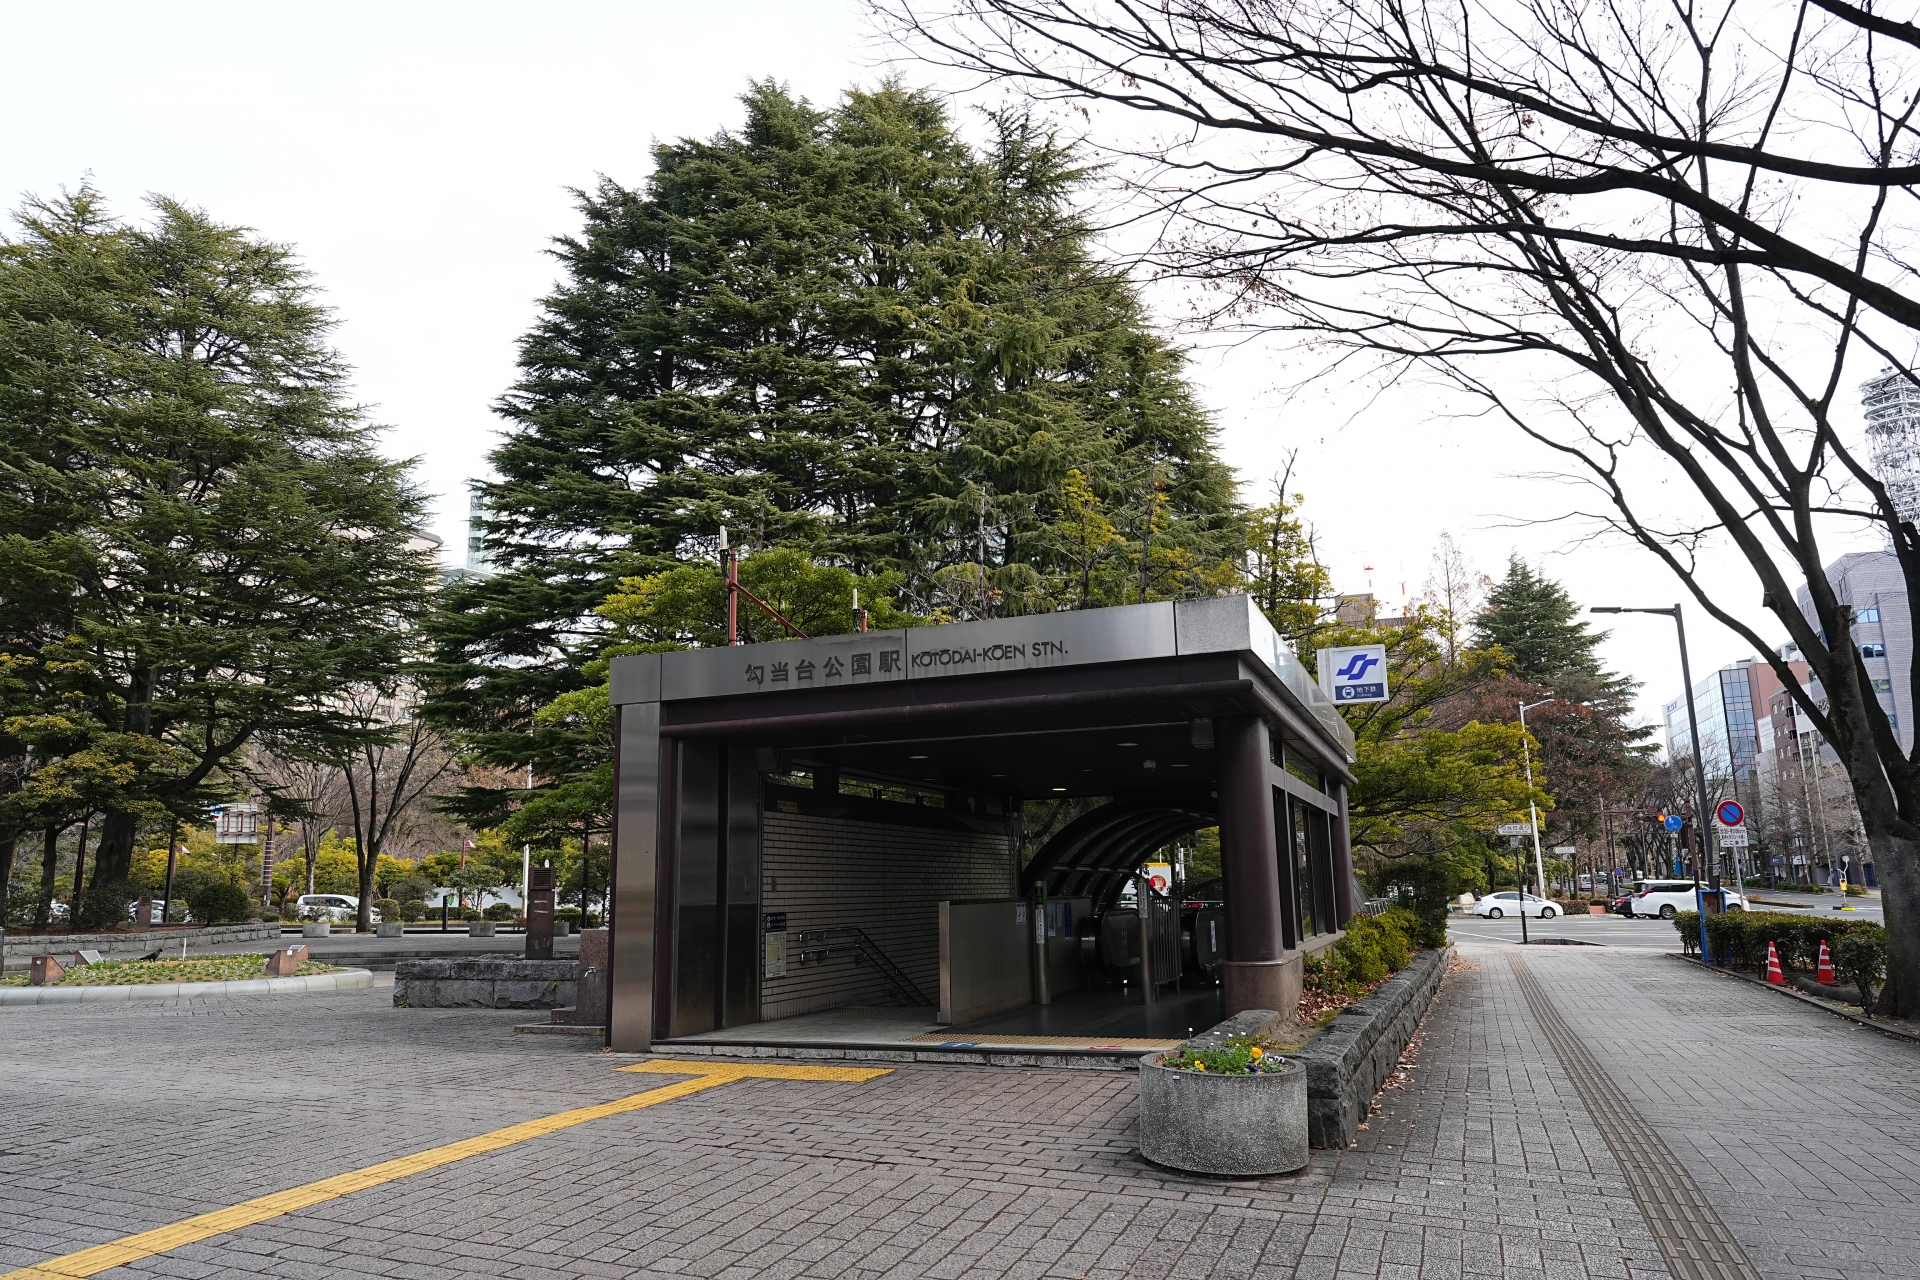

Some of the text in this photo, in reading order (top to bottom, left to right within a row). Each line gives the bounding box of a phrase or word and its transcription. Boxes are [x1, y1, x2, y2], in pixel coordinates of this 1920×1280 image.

[1031, 640, 1069, 658] STN.
[744, 650, 902, 685] 勾当台公園駅
[1356, 685, 1377, 693] 地下鉄
